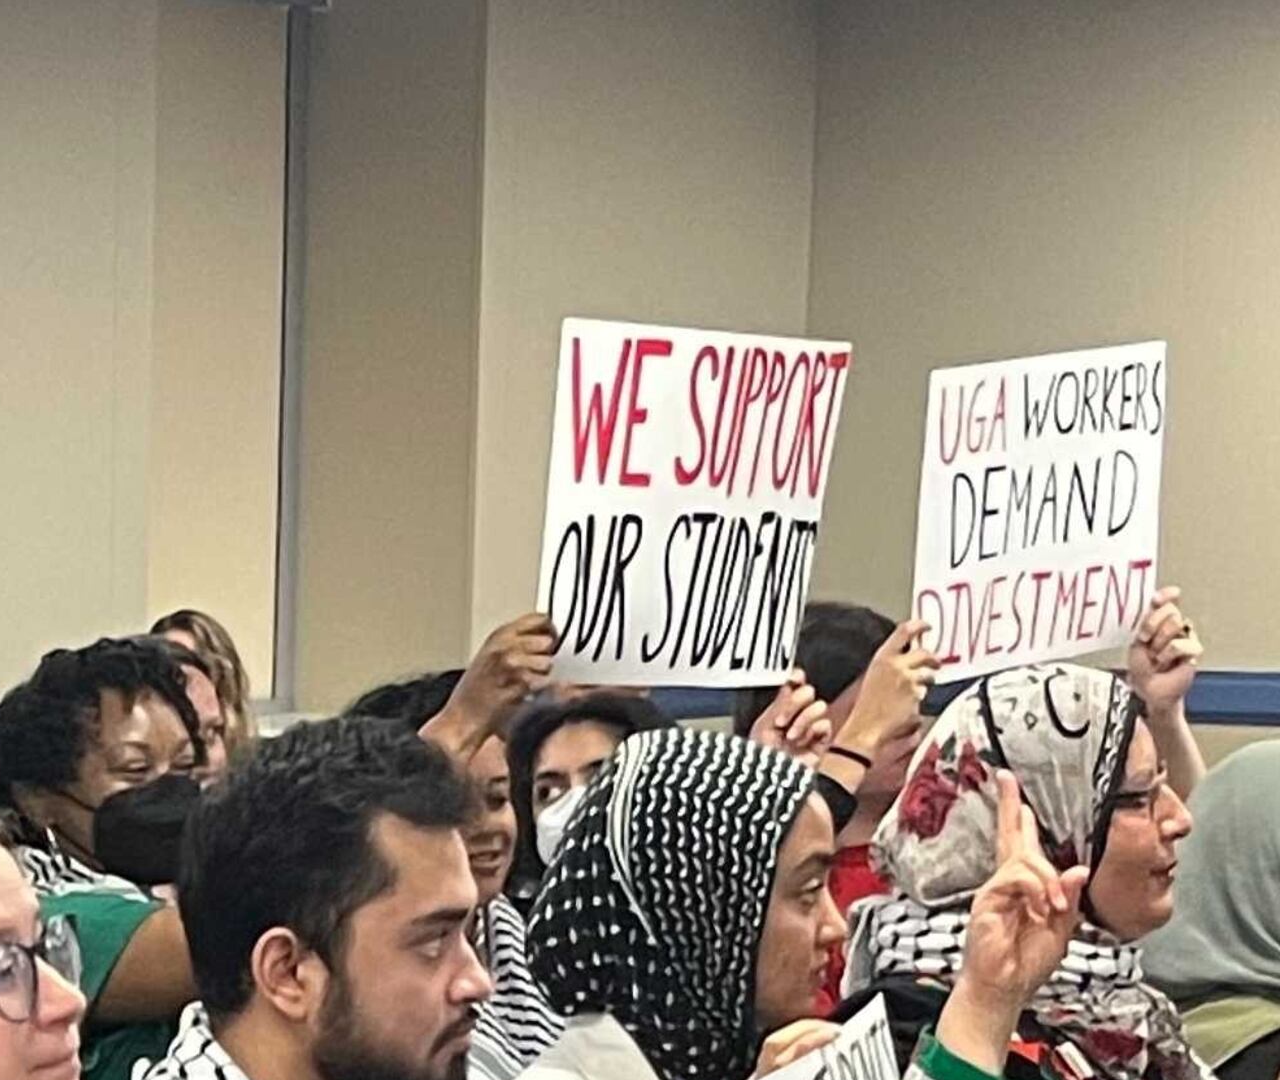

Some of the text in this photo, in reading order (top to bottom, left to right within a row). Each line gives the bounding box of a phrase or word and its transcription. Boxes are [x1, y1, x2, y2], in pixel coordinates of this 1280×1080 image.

[571, 337, 852, 499] WE SUPPORT
[939, 360, 1162, 465] UGA WORKERS
[950, 450, 1138, 569] DEMAND
[549, 511, 818, 671] OUR STUDENTS
[917, 560, 1152, 665] DIVESTMENT
